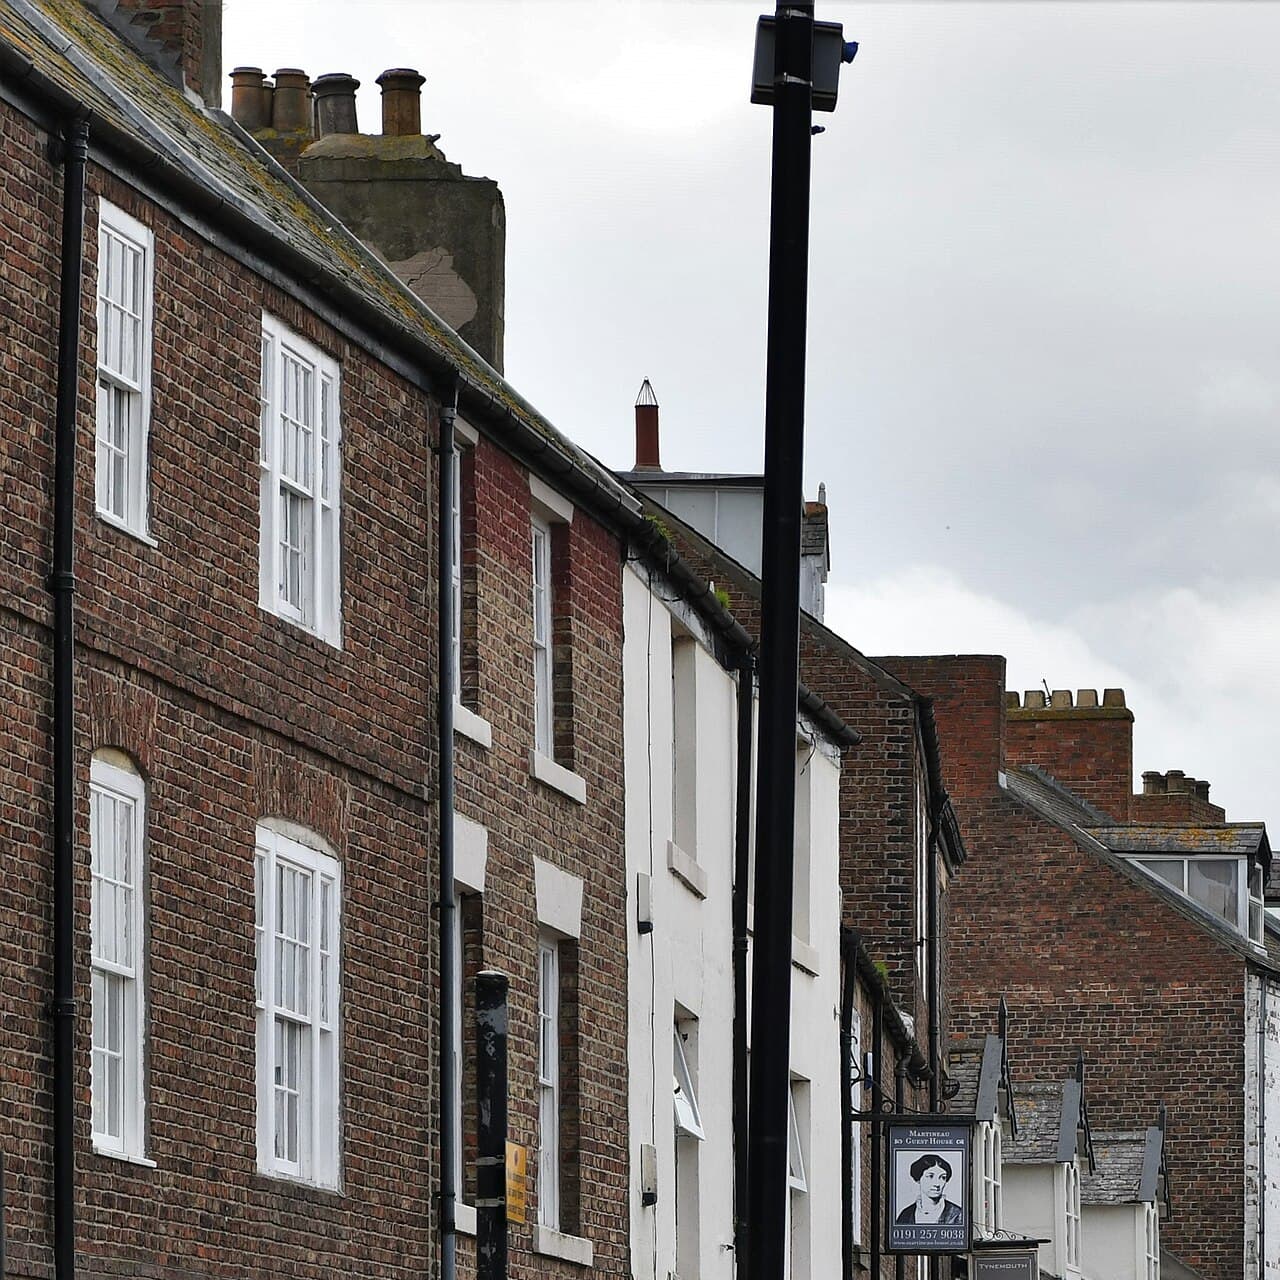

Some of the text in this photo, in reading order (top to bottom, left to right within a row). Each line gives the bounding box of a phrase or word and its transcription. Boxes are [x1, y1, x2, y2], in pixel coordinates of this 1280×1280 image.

[893, 1229, 965, 1239] 0191 257 9038
